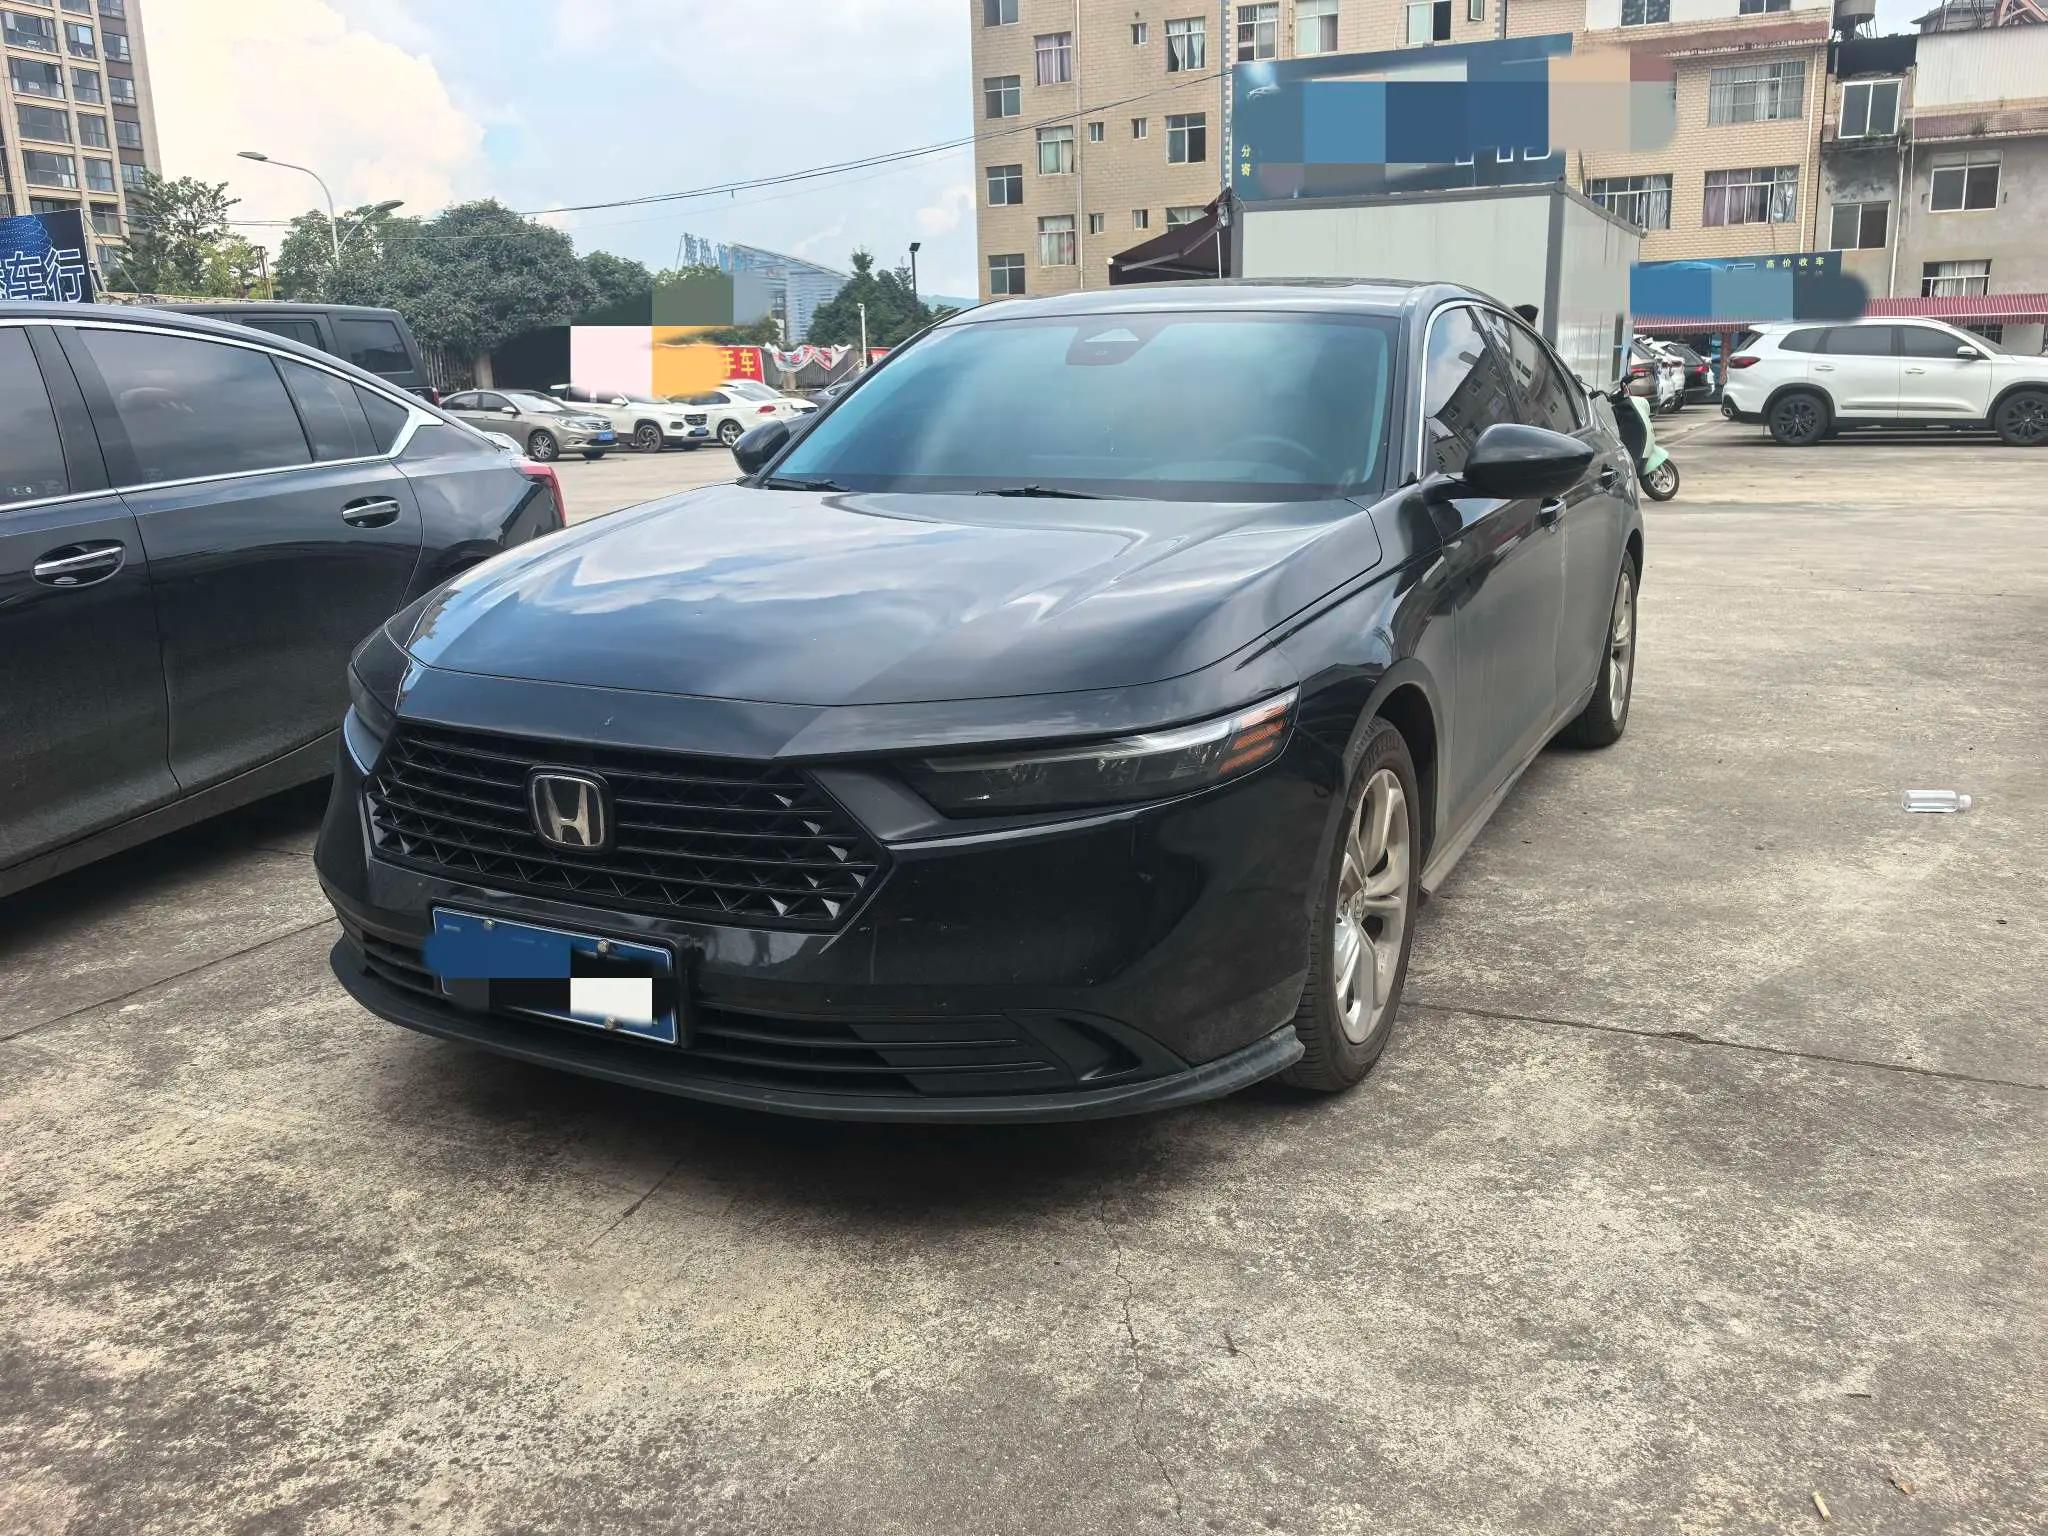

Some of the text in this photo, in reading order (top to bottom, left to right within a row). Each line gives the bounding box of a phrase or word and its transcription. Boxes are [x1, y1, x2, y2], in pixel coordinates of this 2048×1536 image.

[0, 247, 85, 302] 车行
[1765, 256, 1825, 269] 高价收车
